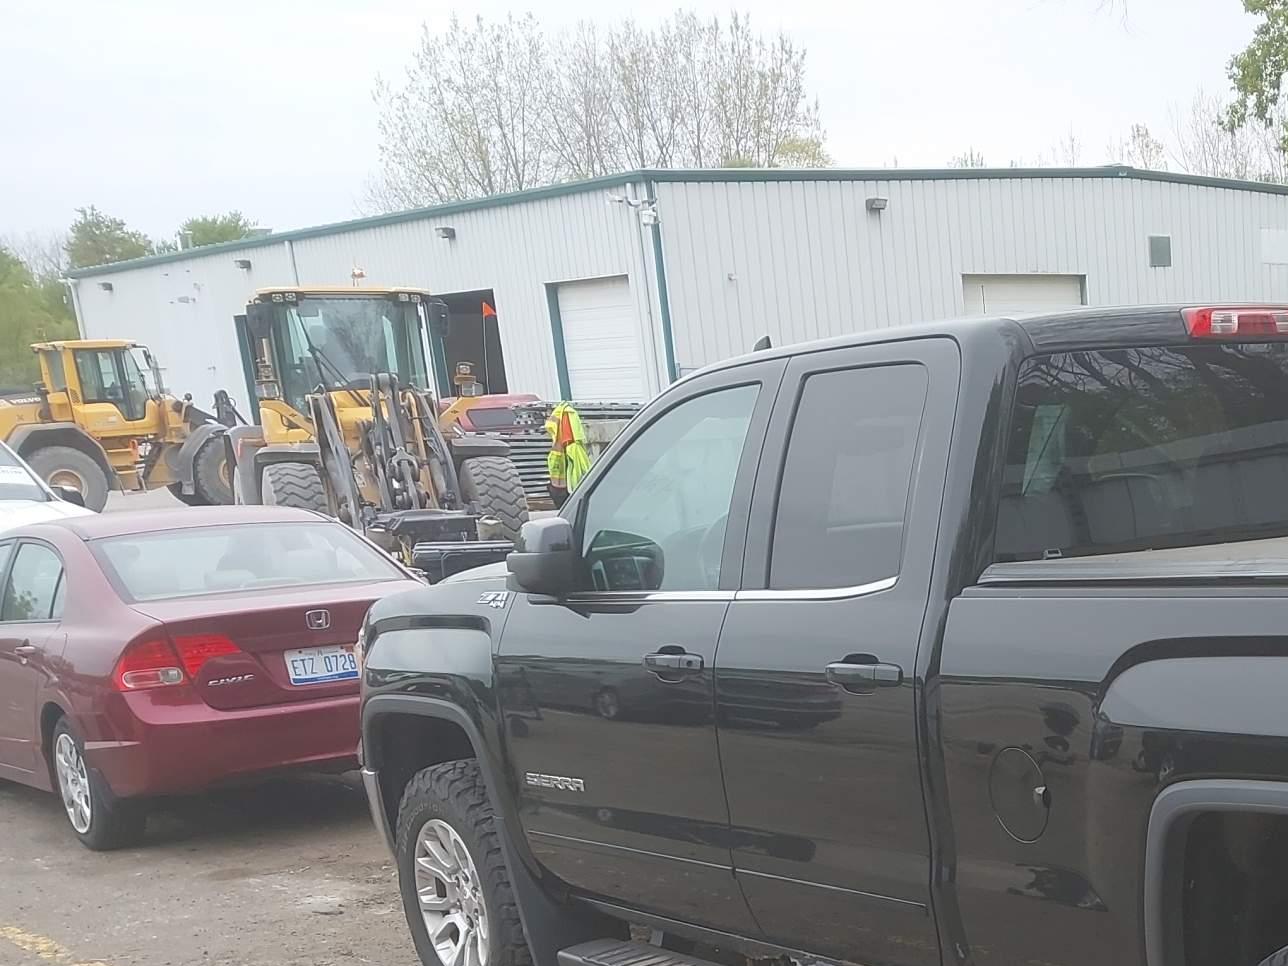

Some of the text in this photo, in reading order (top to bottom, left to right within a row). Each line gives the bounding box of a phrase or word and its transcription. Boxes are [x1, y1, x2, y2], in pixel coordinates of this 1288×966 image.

[290, 653, 357, 676] ETZ 0728
[207, 674, 254, 687] CIVIC
[526, 772, 585, 792] SIERRA
